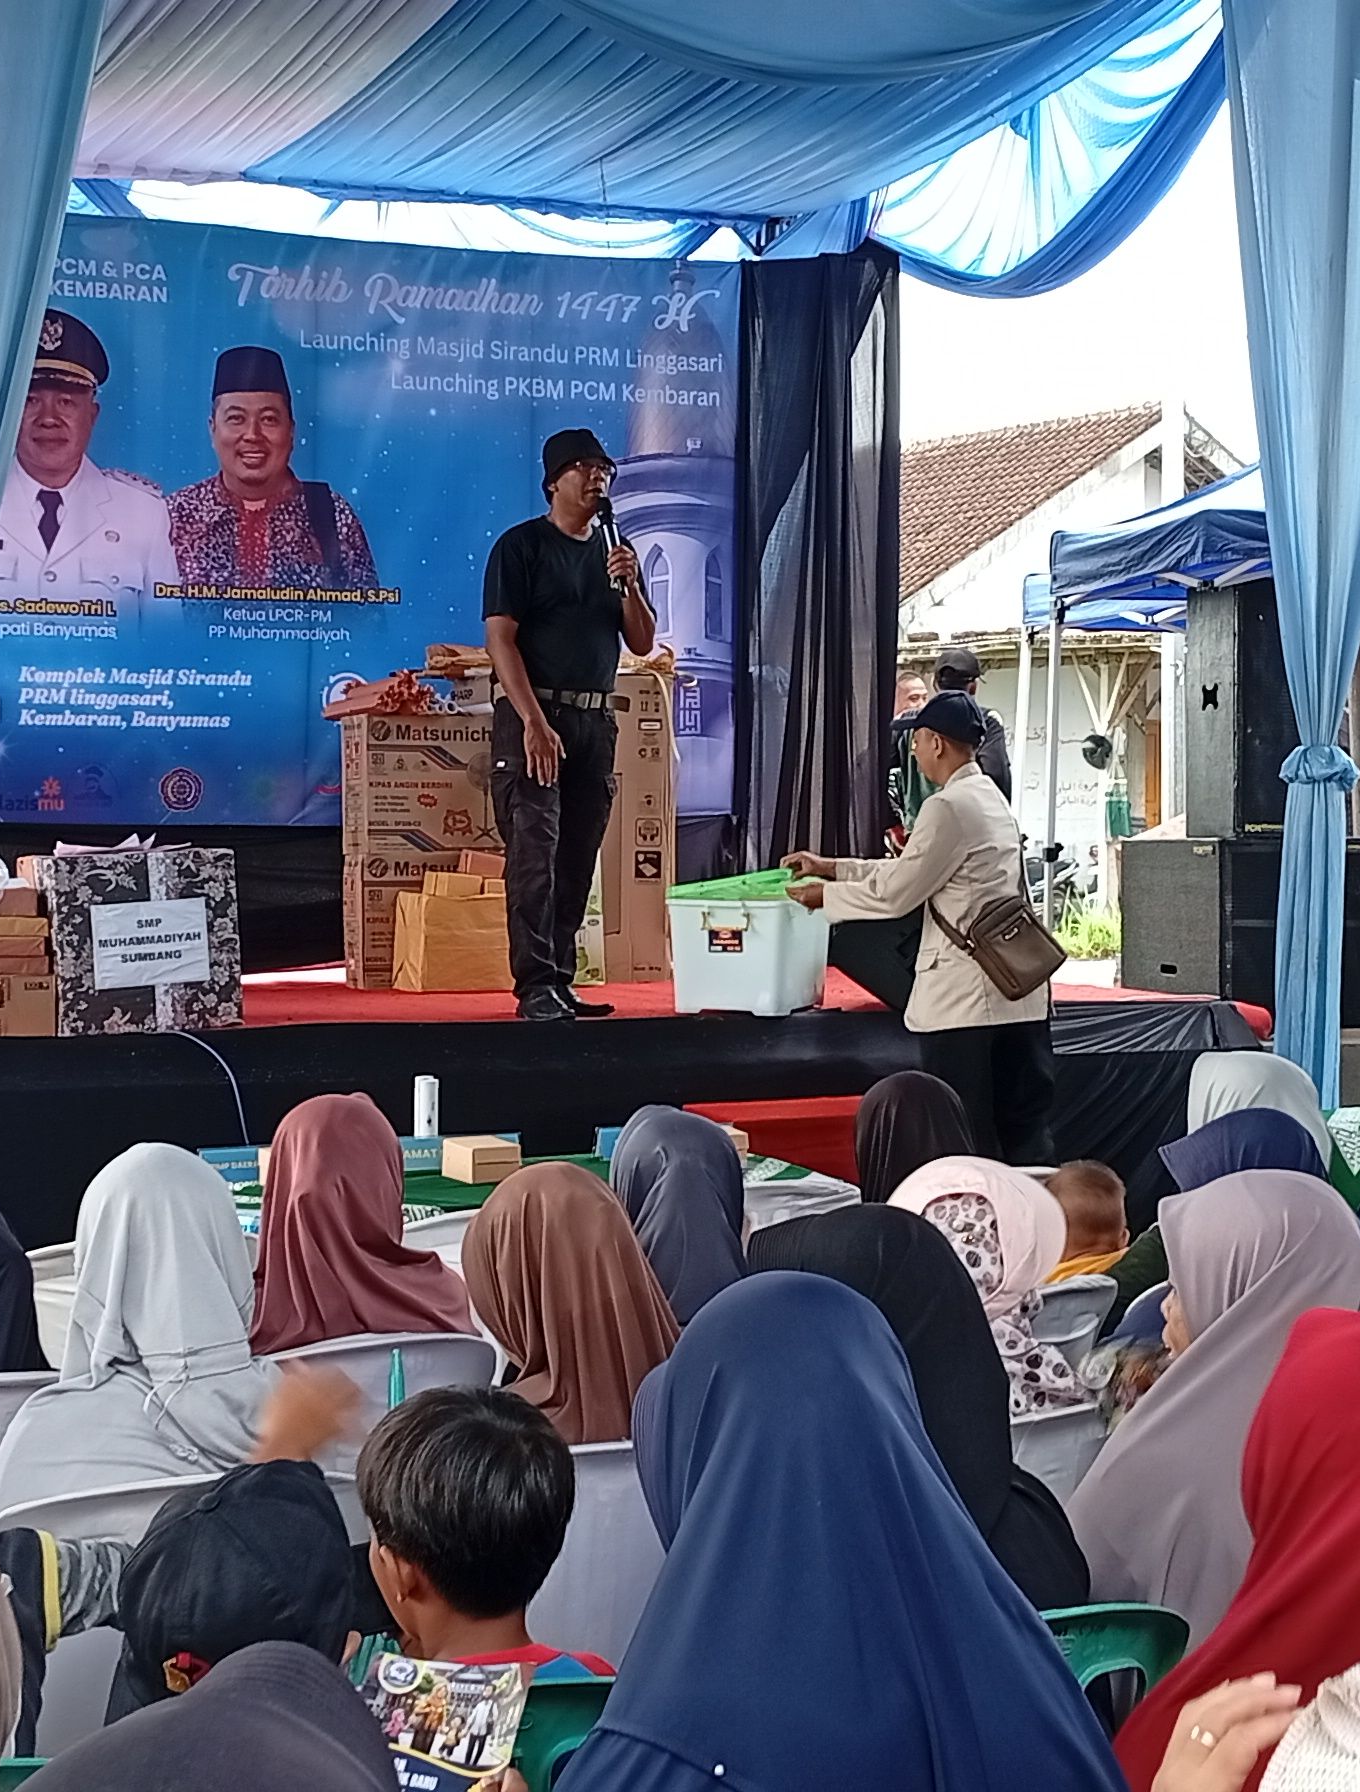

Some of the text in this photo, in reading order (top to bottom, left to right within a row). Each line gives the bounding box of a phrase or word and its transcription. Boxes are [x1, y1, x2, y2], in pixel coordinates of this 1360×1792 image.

[102, 261, 118, 277] &
[123, 263, 167, 281] PCA
[50, 279, 167, 303] KEMBARAN
[227, 263, 353, 307] Tarhib
[364, 272, 544, 324] Ramadhan
[557, 291, 642, 323] 1447
[300, 330, 723, 375] Launching Masjid Sirandu PRM Linggasari
[392, 373, 720, 406] Launching PKBM PCM Kembaran
[155, 584, 183, 597] Drs.
[187, 585, 220, 598] H.M.
[223, 586, 304, 600] Jamaludin
[307, 588, 365, 604] Ahmad,
[15, 600, 79, 614] Sadewo
[81, 601, 102, 615] Tri
[224, 608, 332, 623] Ketua LPCR-PM
[34, 622, 117, 641] Banyumas
[209, 626, 352, 644] PP Muhammadiyah
[18, 666, 252, 689] Komplek Masjid Sirandu
[18, 687, 65, 704] PRM
[18, 709, 231, 732] Kembaran, Banyumas
[136, 918, 162, 929] SMP
[98, 931, 202, 949] MUHAMMADIYAH
